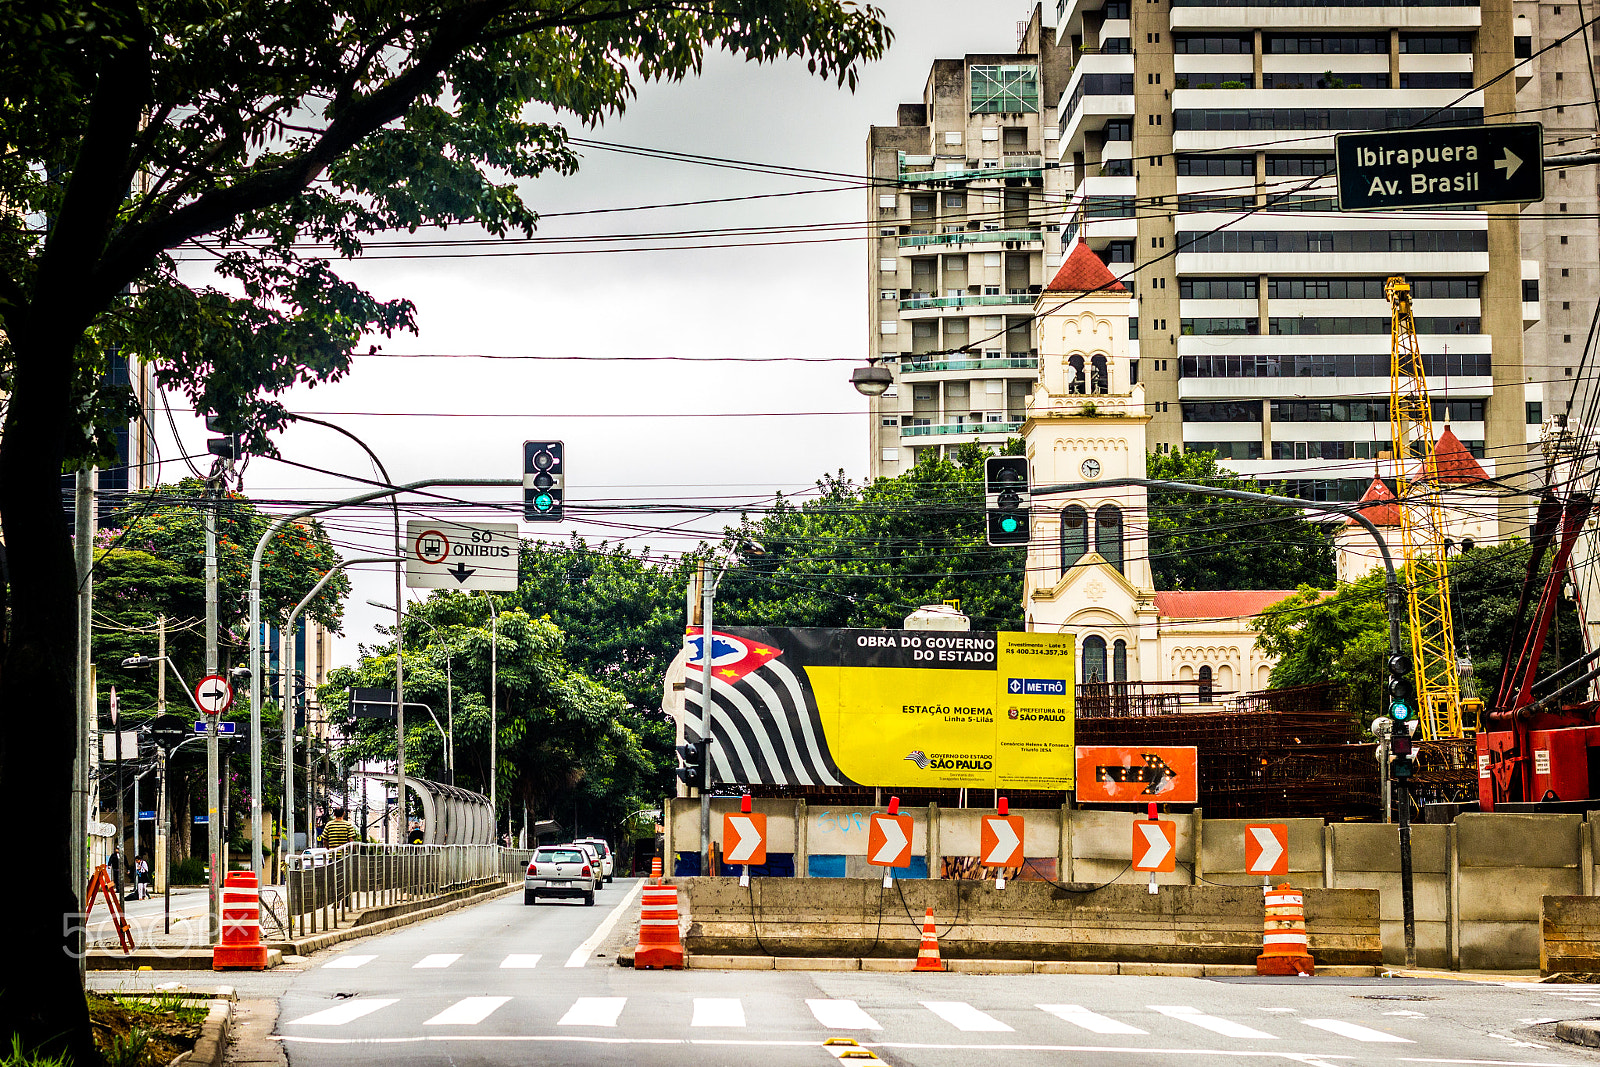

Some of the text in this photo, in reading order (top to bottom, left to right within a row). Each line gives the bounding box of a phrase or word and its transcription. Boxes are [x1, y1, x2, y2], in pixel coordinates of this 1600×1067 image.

[1357, 145, 1478, 168] Ibirapuera
[1367, 172, 1479, 196] Av. Brasil
[471, 530, 493, 543] SÓ
[453, 542, 510, 557] ÔNIBUS
[857, 636, 995, 650] OBRA DO GOVERNO
[913, 650, 995, 662] DO ESTADO
[1027, 681, 1063, 692] METRÔ
[902, 704, 993, 715] ESTAÇÃO MOEMA
[1020, 713, 1066, 722] SÃO PAULO
[930, 758, 993, 770] SÃO PAULO
